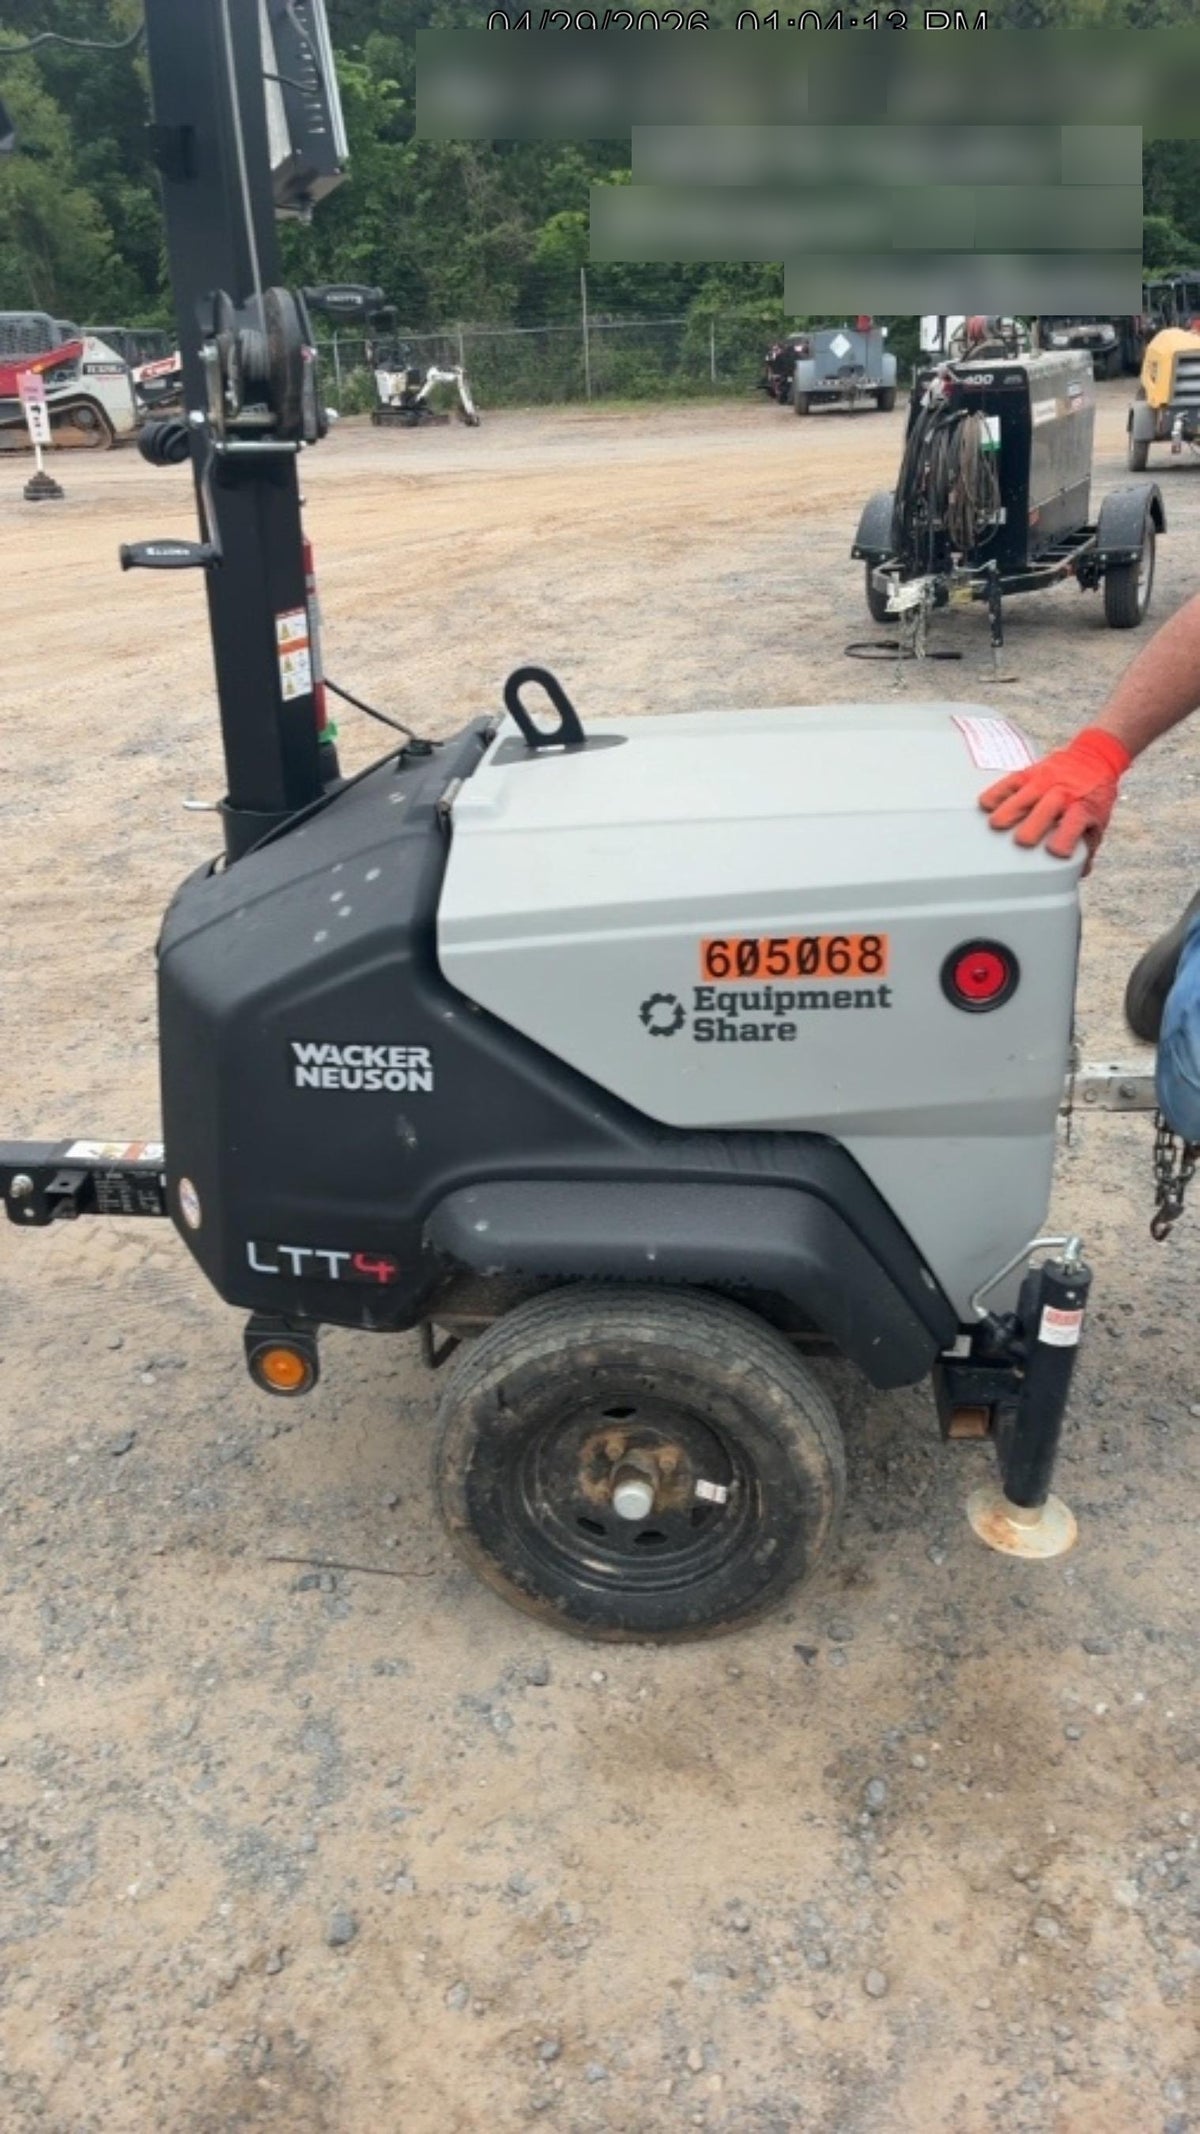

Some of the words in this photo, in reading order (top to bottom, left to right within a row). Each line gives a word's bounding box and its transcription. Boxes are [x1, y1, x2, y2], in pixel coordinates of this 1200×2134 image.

[705, 935, 883, 978] 605068
[693, 984, 892, 1017] Equipment
[693, 1018, 797, 1041] Share
[291, 1042, 432, 1068] WACKER
[295, 1065, 433, 1091] NEUSON
[246, 1241, 395, 1284] LTT4
